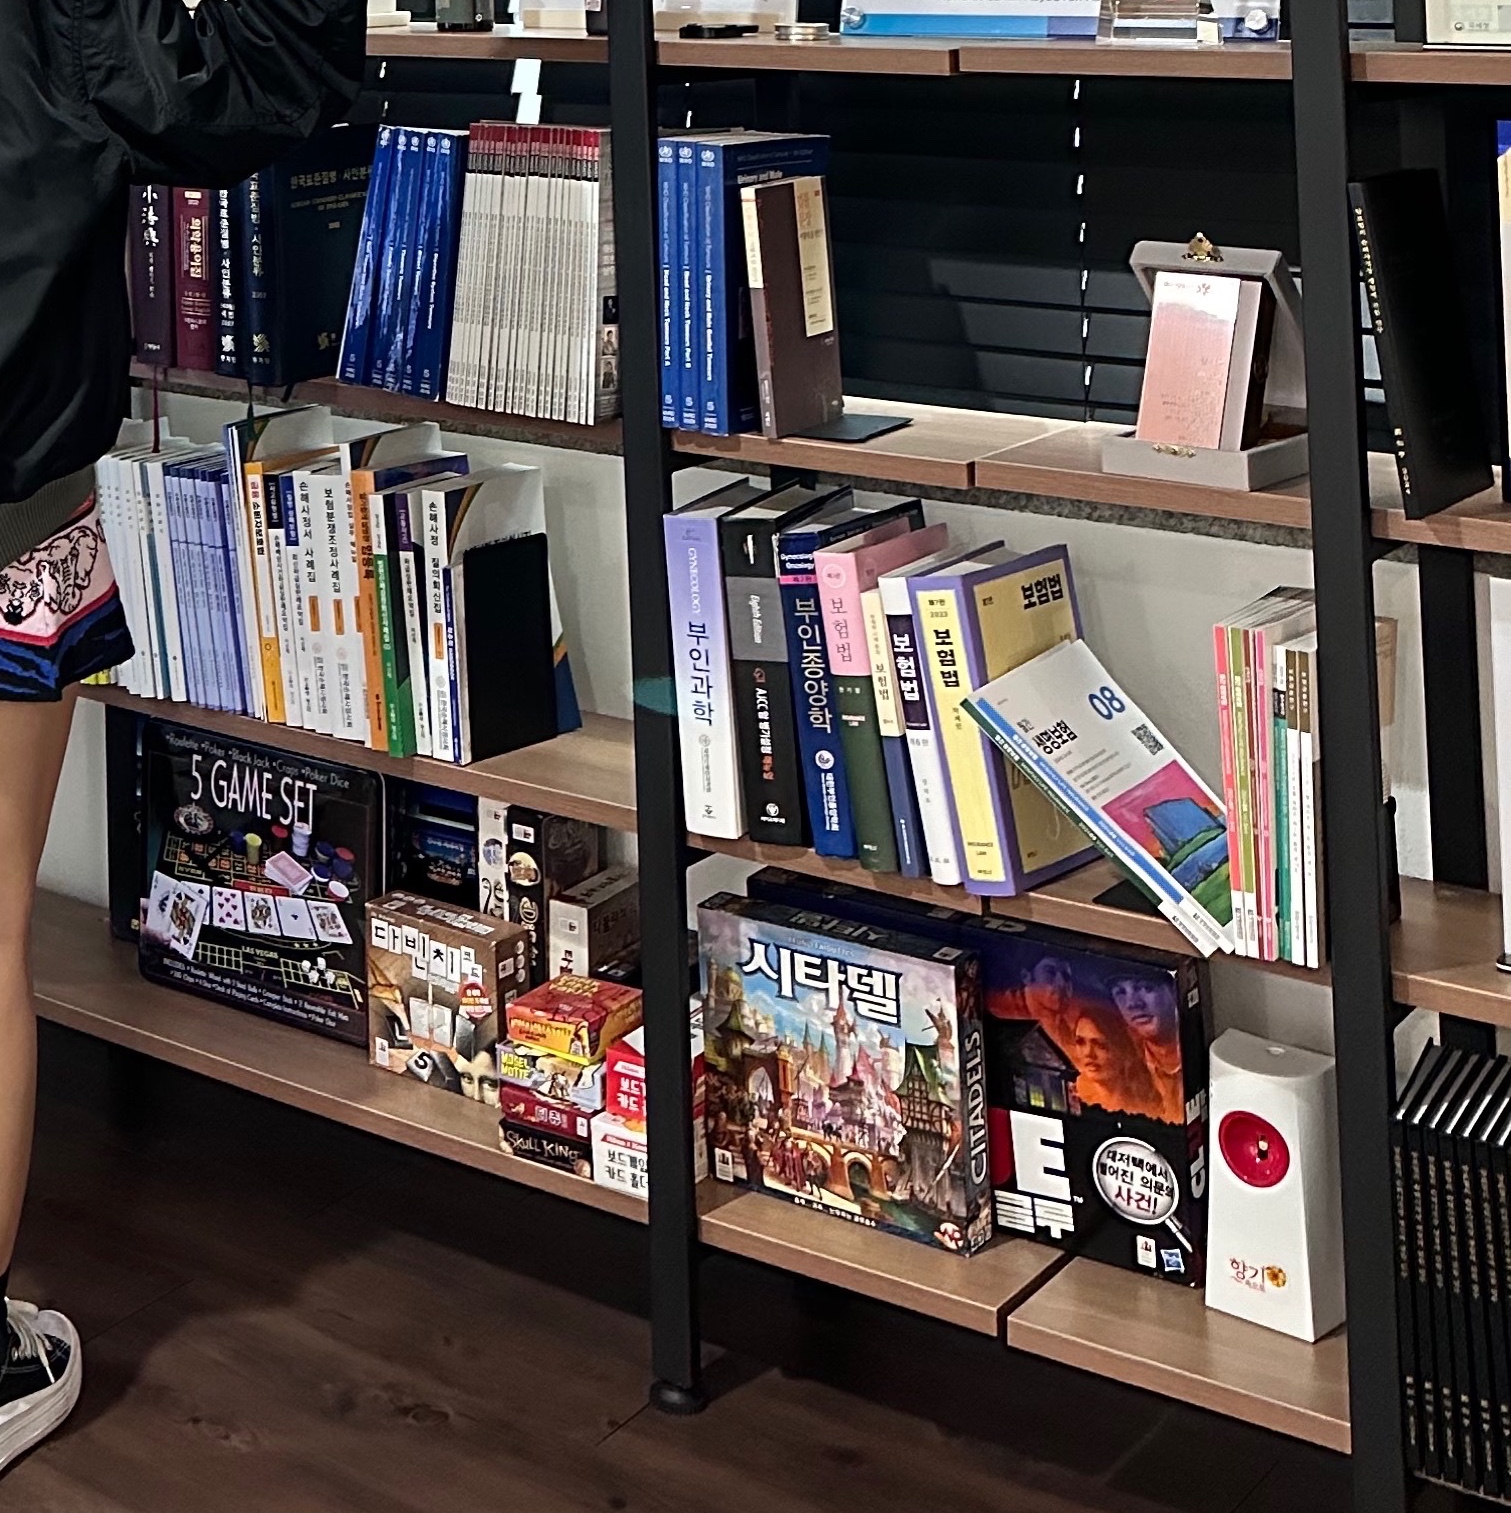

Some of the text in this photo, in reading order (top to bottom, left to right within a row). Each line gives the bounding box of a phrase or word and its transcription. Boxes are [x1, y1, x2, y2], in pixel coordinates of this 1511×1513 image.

[299, 481, 316, 583] 손해사정서 사례집
[323, 488, 341, 593] 보험분쟁조정사례집
[428, 501, 439, 546] 손해사정
[361, 545, 374, 580] 암등록
[687, 547, 701, 616] GYNECOLOGY
[1022, 573, 1065, 610] 보험법
[749, 594, 763, 644] Eighth Edition
[829, 597, 852, 663] 보험법
[793, 596, 834, 736] 부인종양학
[893, 633, 920, 701] 보험법
[933, 628, 960, 688] 보험법
[755, 687, 767, 710] AJCC
[874, 662, 891, 701] 보험법
[1088, 686, 1126, 721] 08
[758, 721, 771, 754] 병기설정
[1031, 719, 1078, 755] 생명보험
[203, 742, 225, 757] Poker
[231, 748, 253, 764] Black
[253, 754, 270, 768] Jack
[304, 767, 328, 782] Poker
[329, 772, 350, 789] Dice
[190, 753, 318, 832] 5 GAME SET
[241, 945, 279, 960] LAS VEGAS
[374, 925, 455, 975] 다빈치
[741, 938, 904, 1028] 시타델
[616, 1095, 640, 1112] 카드
[963, 1031, 987, 1186] CITADELS
[605, 1165, 628, 1183] 카드
[1106, 1149, 1169, 1183] 대저택에서
[1114, 1185, 1158, 1216] 사건!
[1140, 1175, 1174, 1200] 의문의
[1229, 1257, 1265, 1284] 향기
